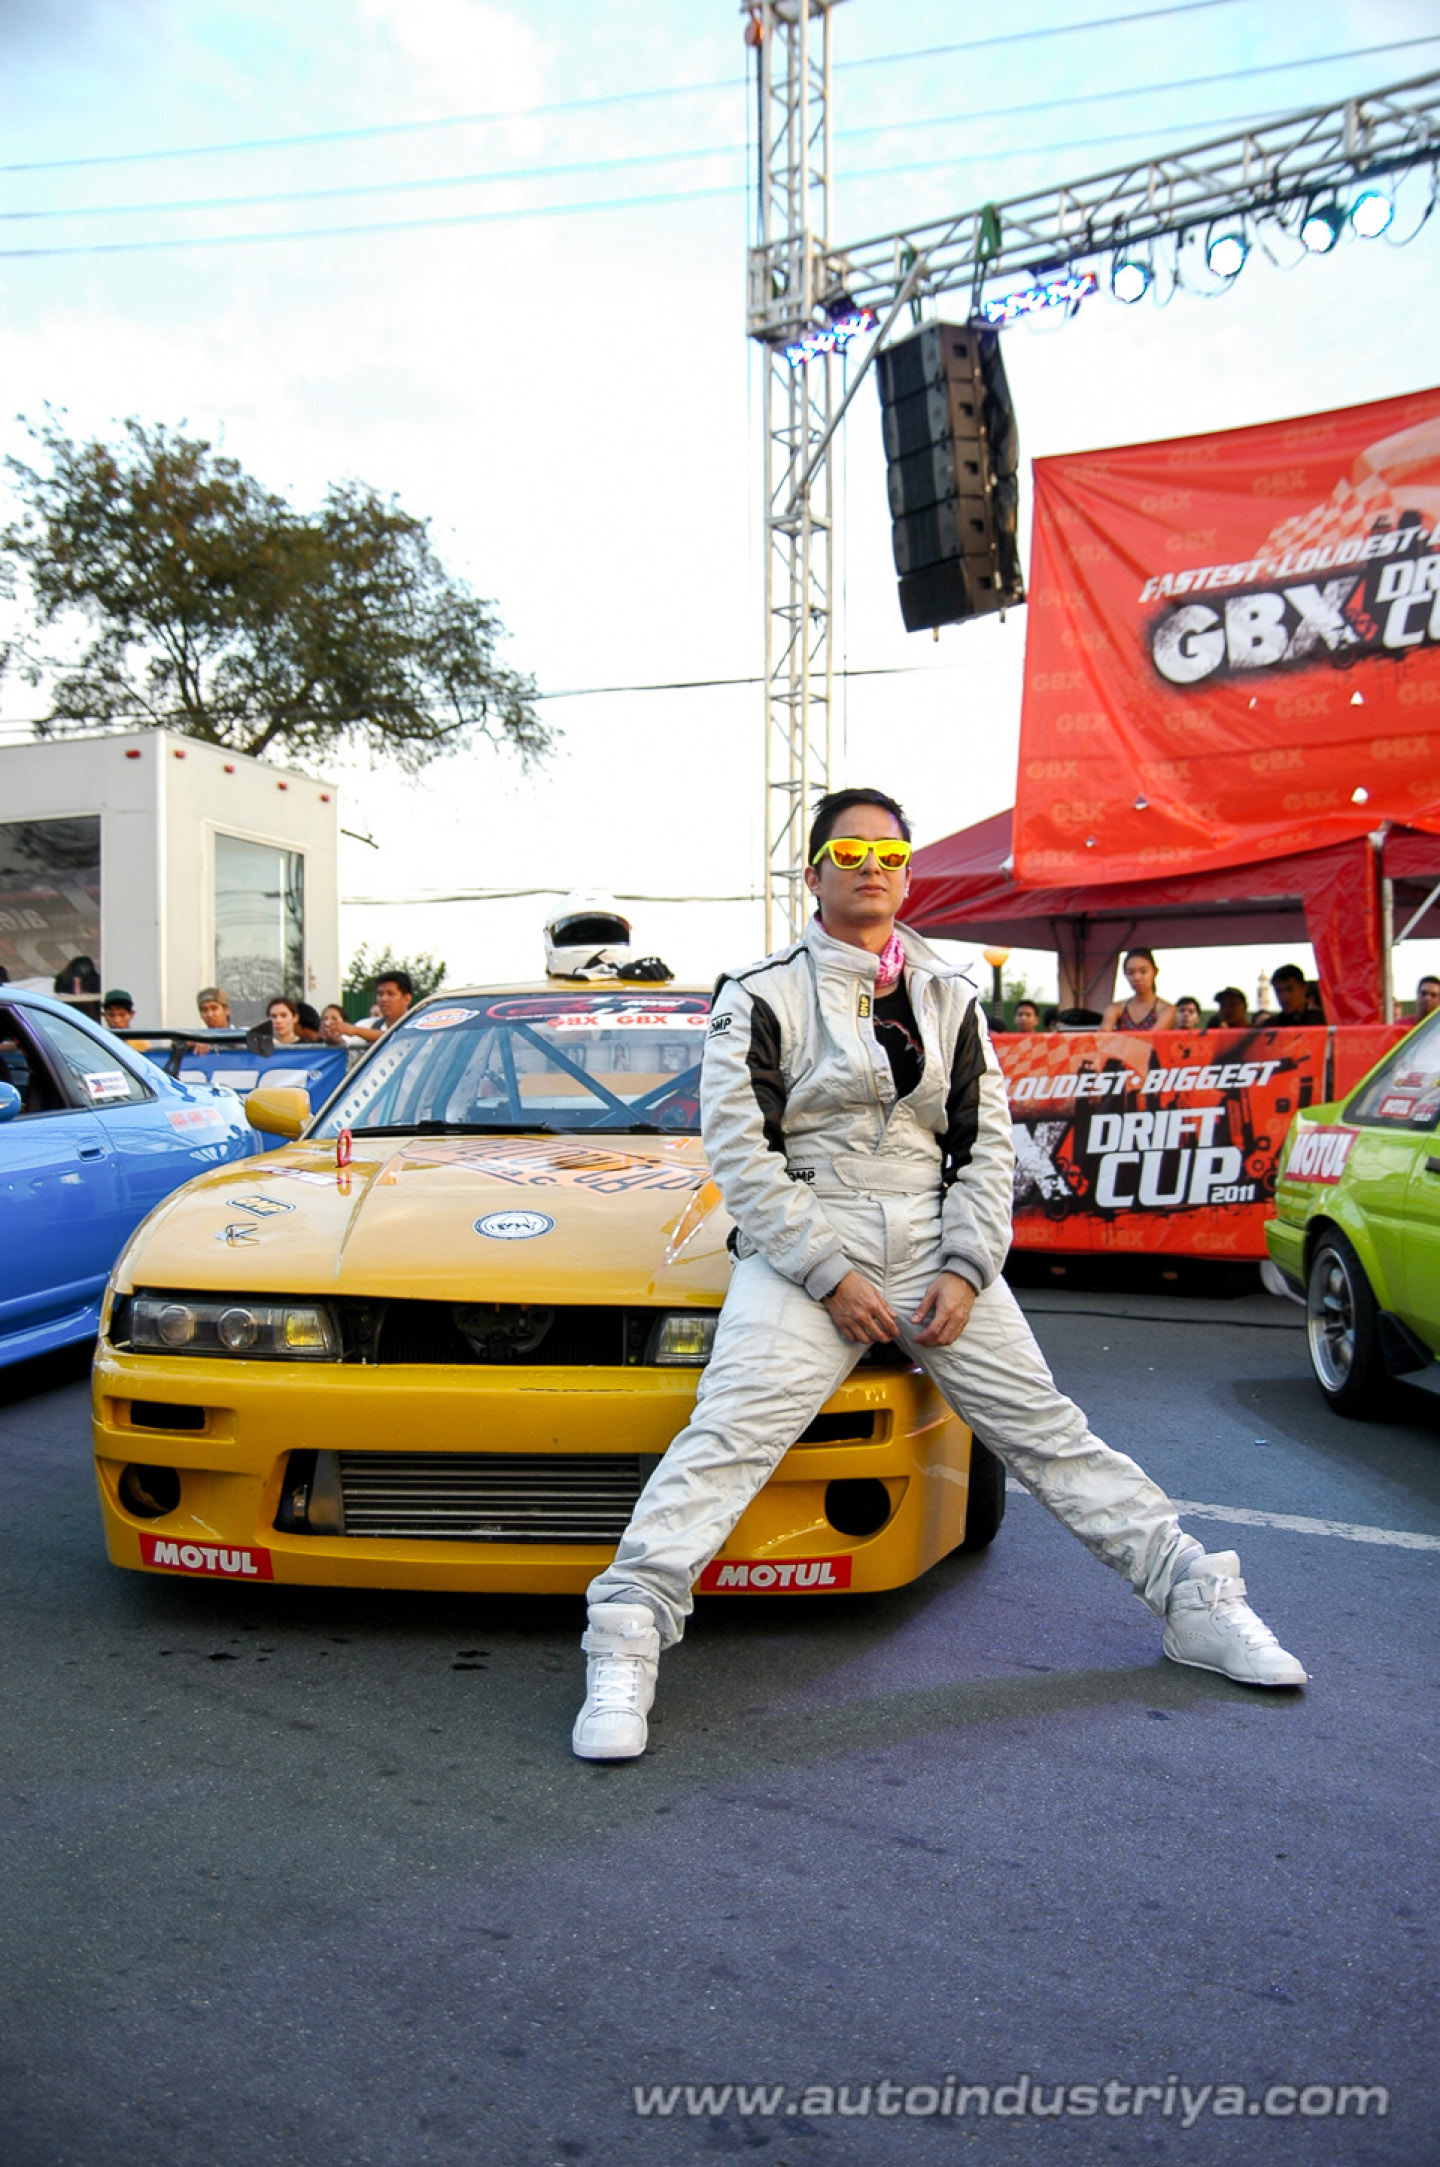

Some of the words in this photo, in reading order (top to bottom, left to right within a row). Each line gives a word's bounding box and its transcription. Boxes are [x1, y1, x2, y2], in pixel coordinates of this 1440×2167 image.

[1138, 558, 1266, 603] FASTEST
[1275, 525, 1422, 578] LOUDEST
[1154, 575, 1360, 684] GBX
[548, 1015, 598, 1028] GBX
[617, 1014, 668, 1024] GBX
[1140, 1061, 1282, 1094] BIGGEST
[1086, 1106, 1225, 1154] DRIFT
[1095, 1146, 1242, 1207] CUP
[1210, 1184, 1256, 1203] 2011
[1285, 1133, 1353, 1178] MOTUL
[154, 1540, 258, 1574] MOTUL
[716, 1562, 836, 1588] MOTUL
